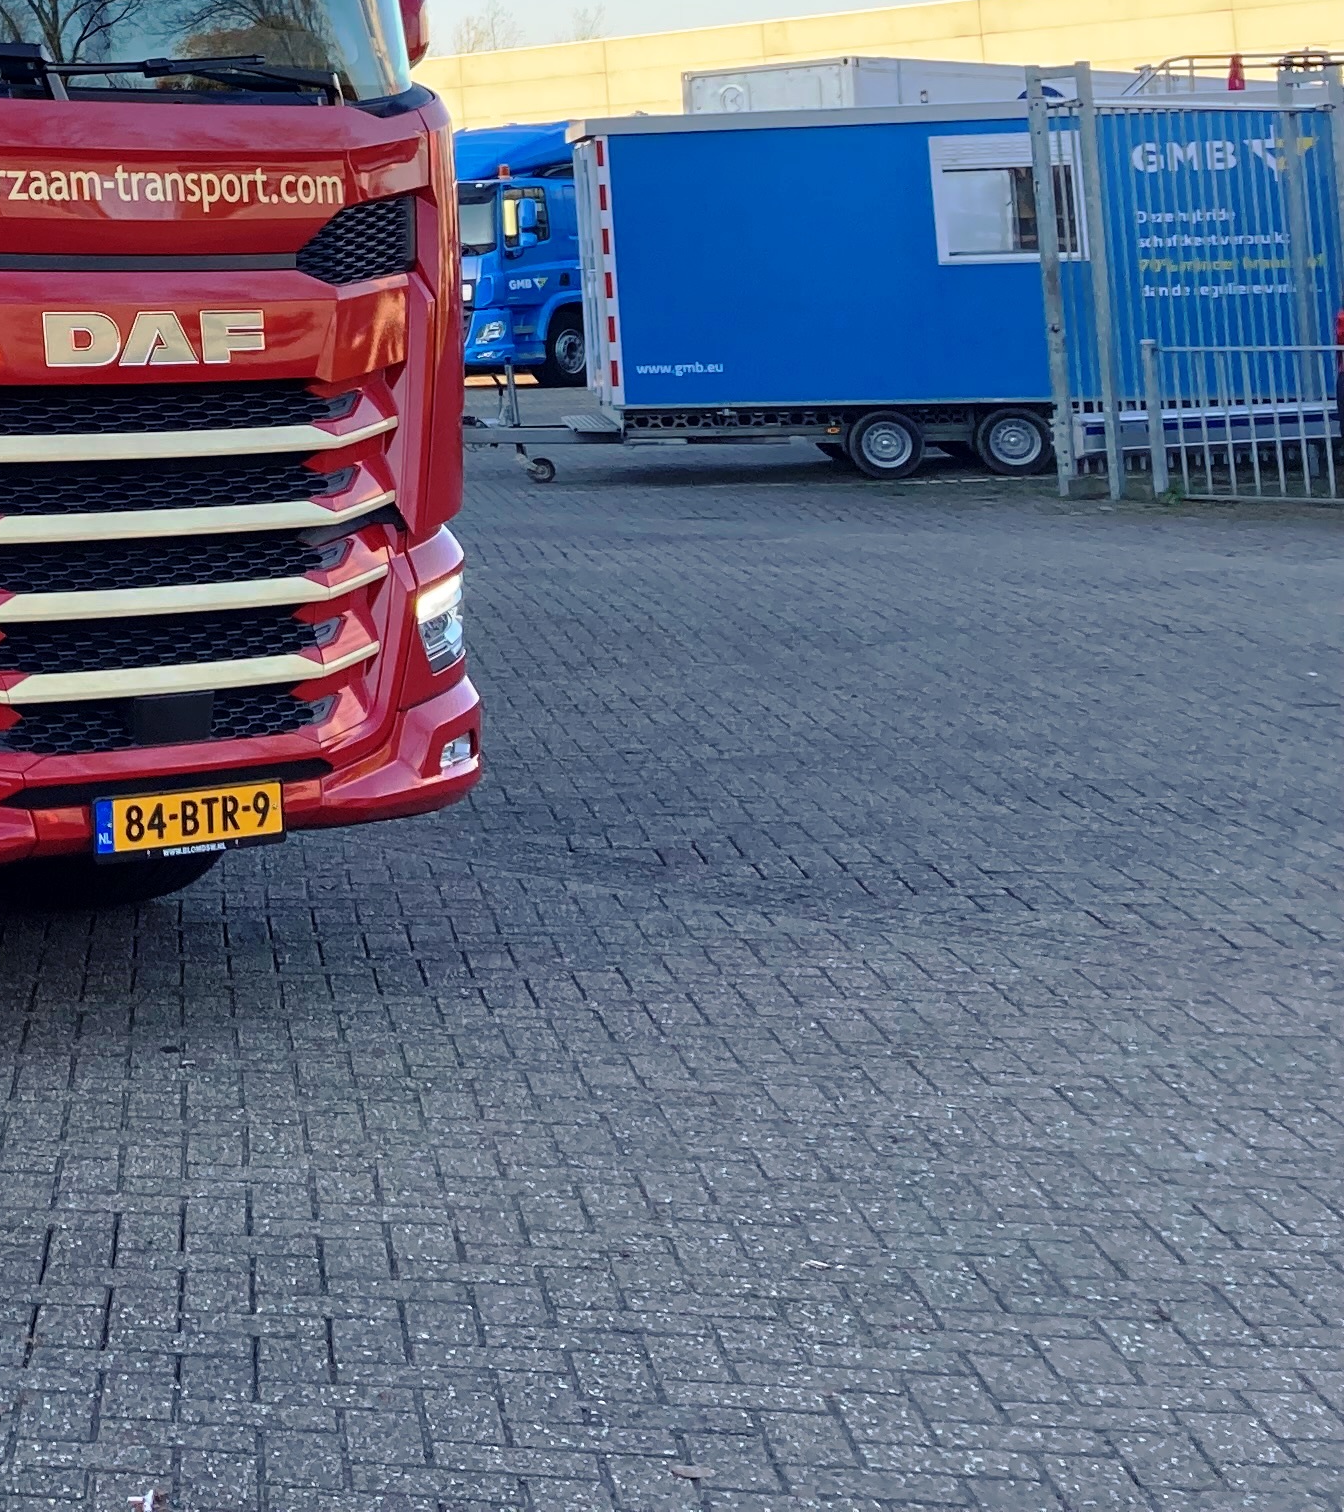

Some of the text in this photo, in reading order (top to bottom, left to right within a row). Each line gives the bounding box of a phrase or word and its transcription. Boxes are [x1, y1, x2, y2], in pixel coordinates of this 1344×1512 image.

[1132, 140, 1238, 173] GMB
[509, 279, 532, 290] GMB
[42, 309, 266, 368] DAF
[636, 362, 724, 377] www.gmb.eu
[125, 791, 270, 842] 84-BTR-9
[98, 833, 113, 845] NL
